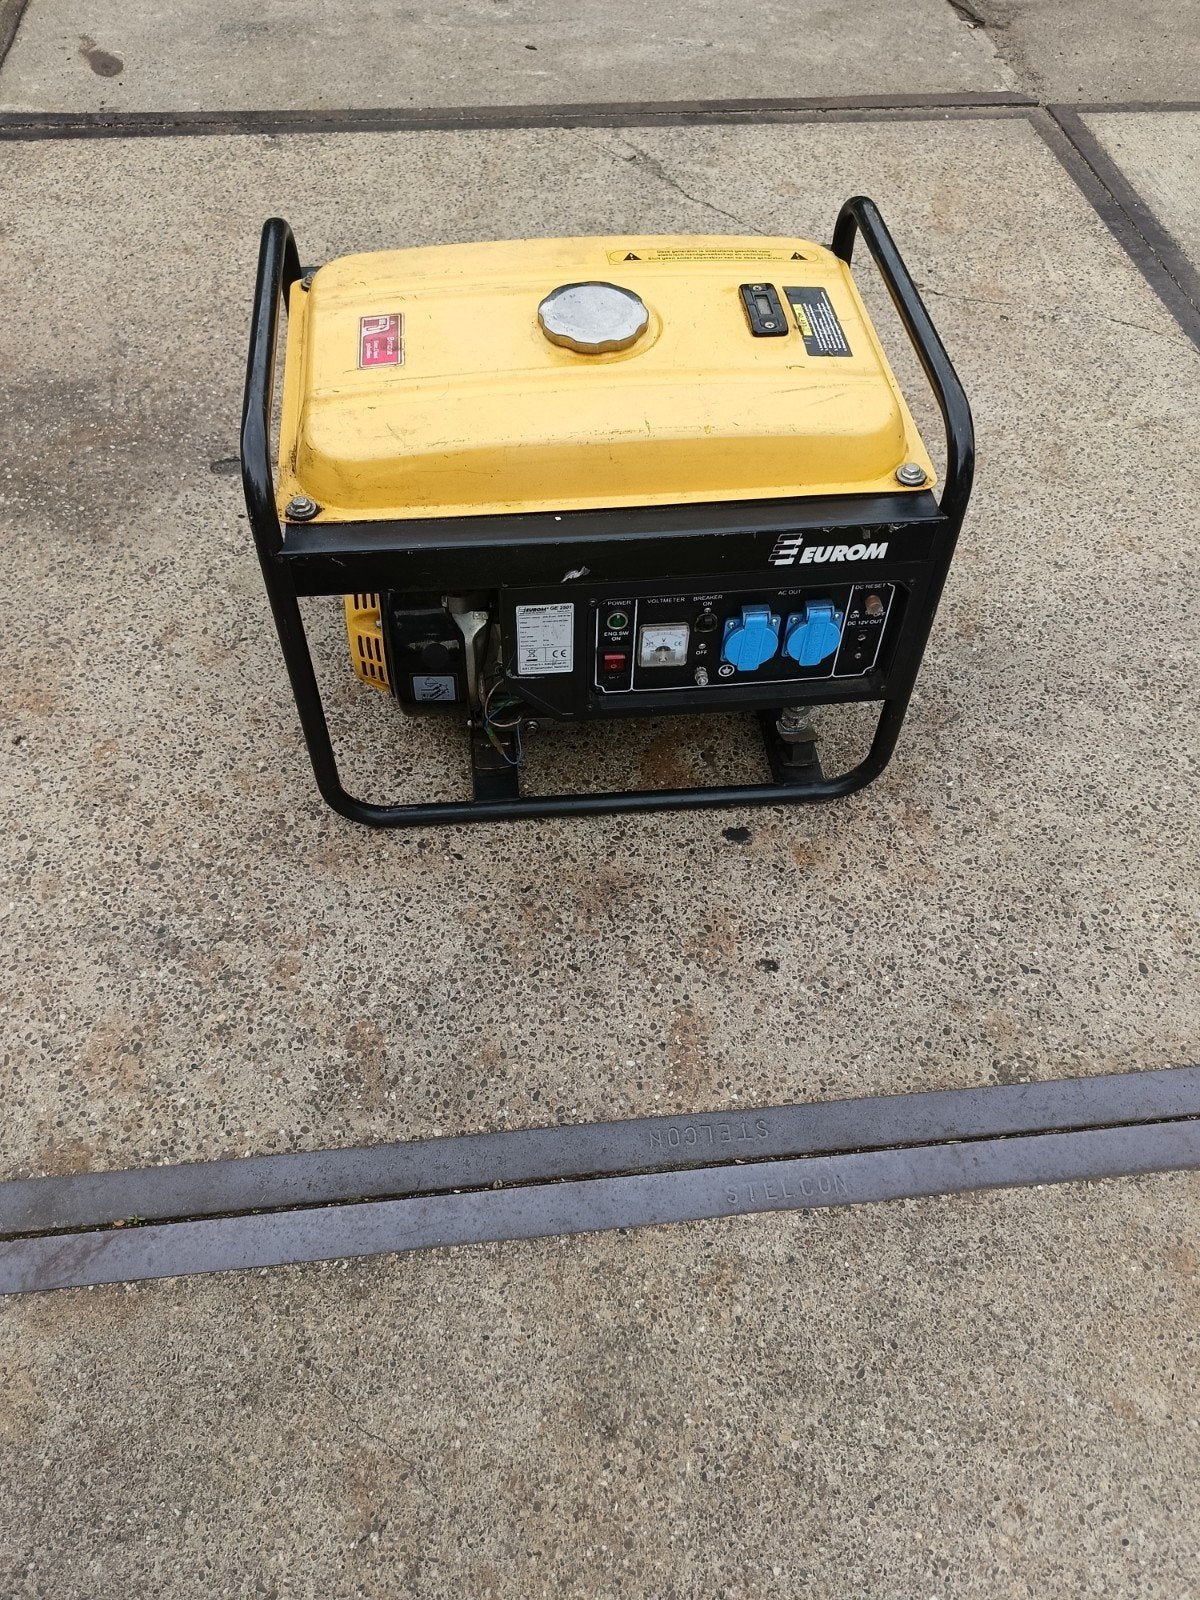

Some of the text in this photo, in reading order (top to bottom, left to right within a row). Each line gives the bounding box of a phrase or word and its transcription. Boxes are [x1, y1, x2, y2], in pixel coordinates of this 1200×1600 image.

[799, 542, 889, 564] EUROM
[693, 594, 723, 602] BREAKER
[649, 1119, 771, 1149] STELCON
[725, 1174, 850, 1205] STELCON
